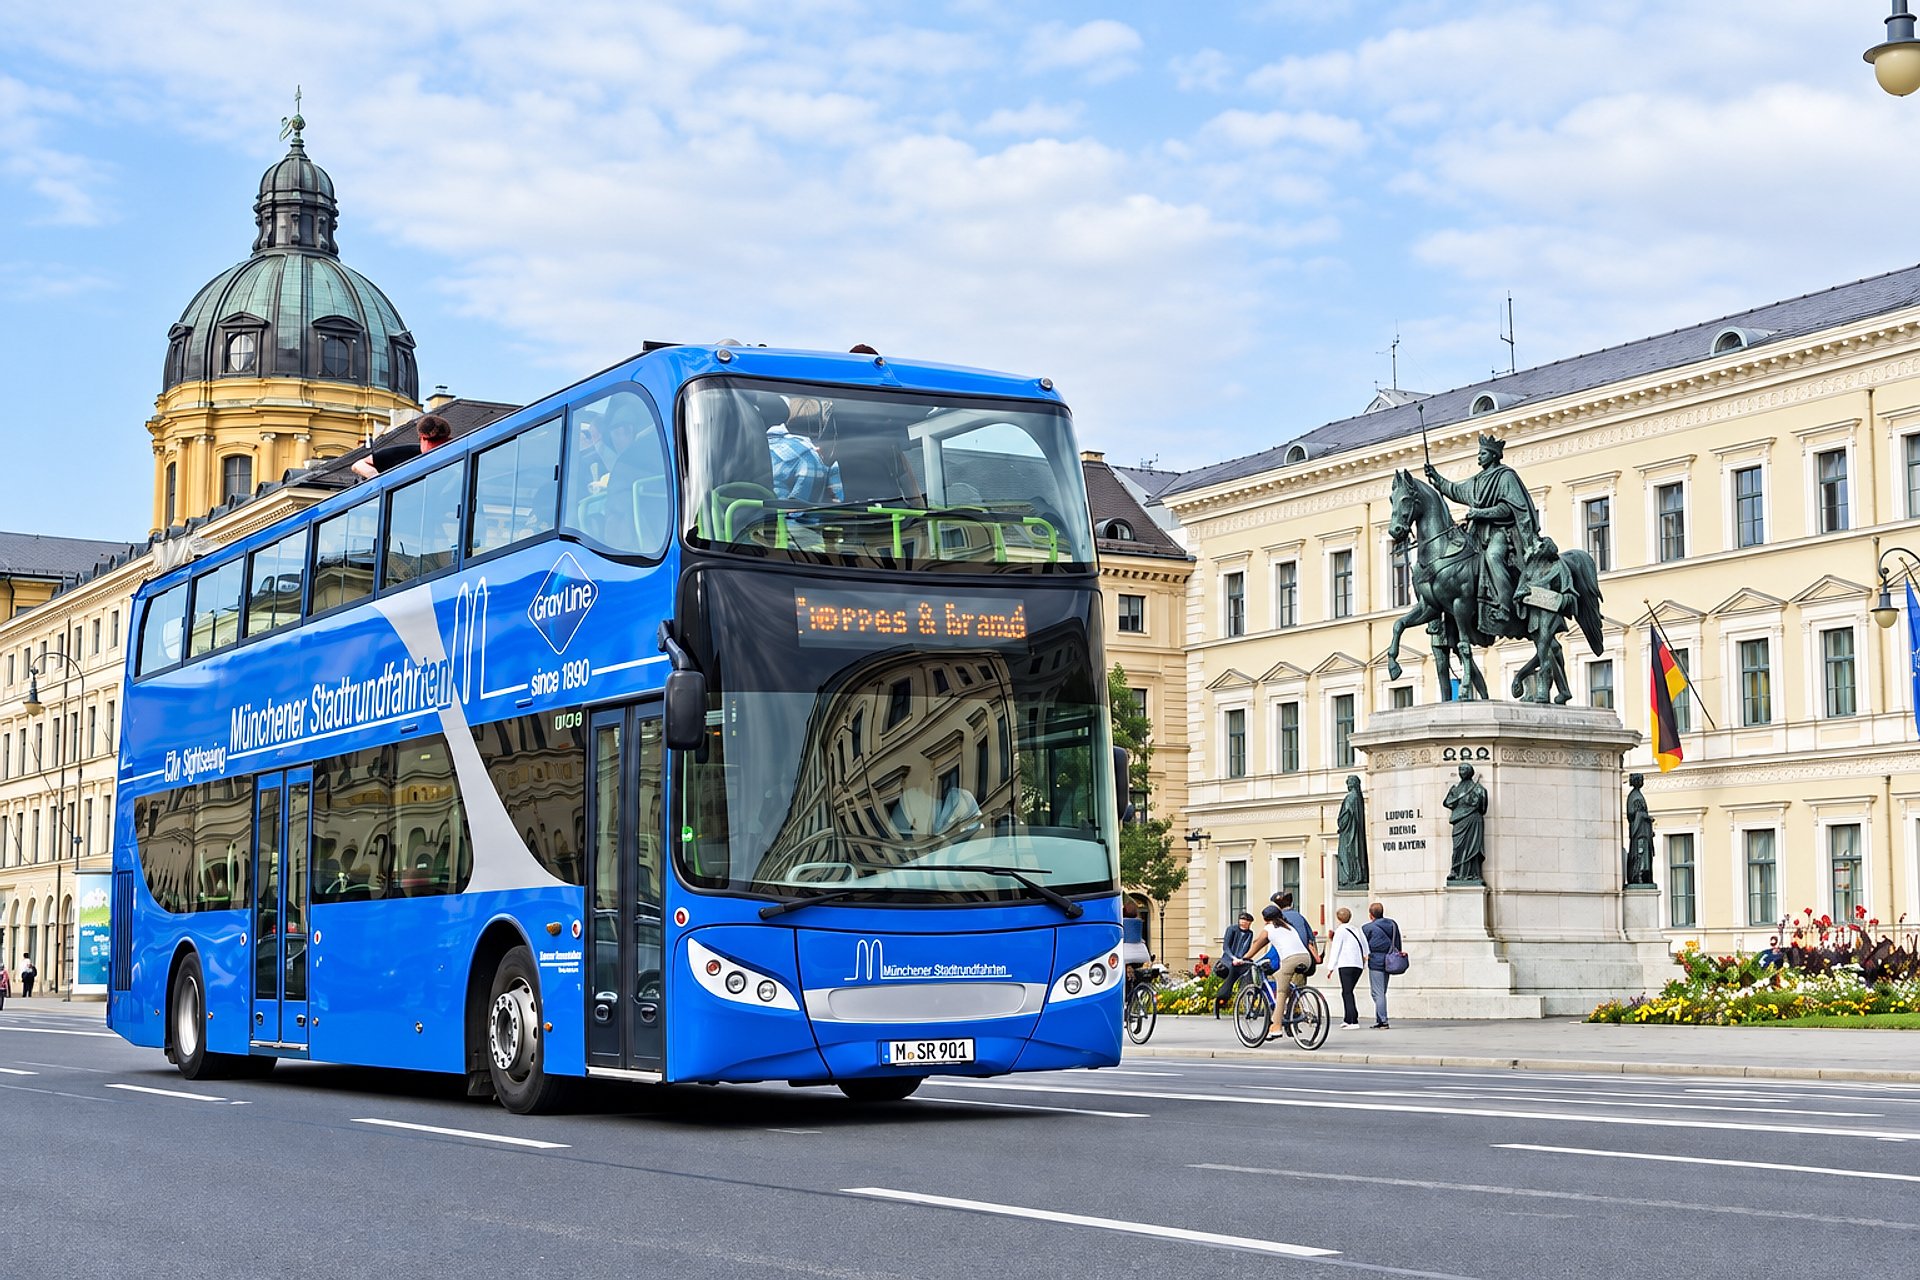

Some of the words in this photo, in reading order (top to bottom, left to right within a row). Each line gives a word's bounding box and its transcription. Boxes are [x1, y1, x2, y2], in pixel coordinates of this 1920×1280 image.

[534, 591, 564, 621] Gray
[565, 583, 592, 613] Line
[531, 668, 559, 697] since
[562, 658, 590, 690] 1890
[229, 698, 308, 753] Münchener
[310, 656, 453, 733] Stadtrundfahrten
[1398, 839, 1426, 851] BAYERN
[883, 964, 932, 977] Münchener
[934, 963, 1007, 977] Stadtrundfahrten
[896, 1043, 906, 1061] M
[917, 1042, 936, 1060] SR
[939, 1041, 967, 1060] 901
